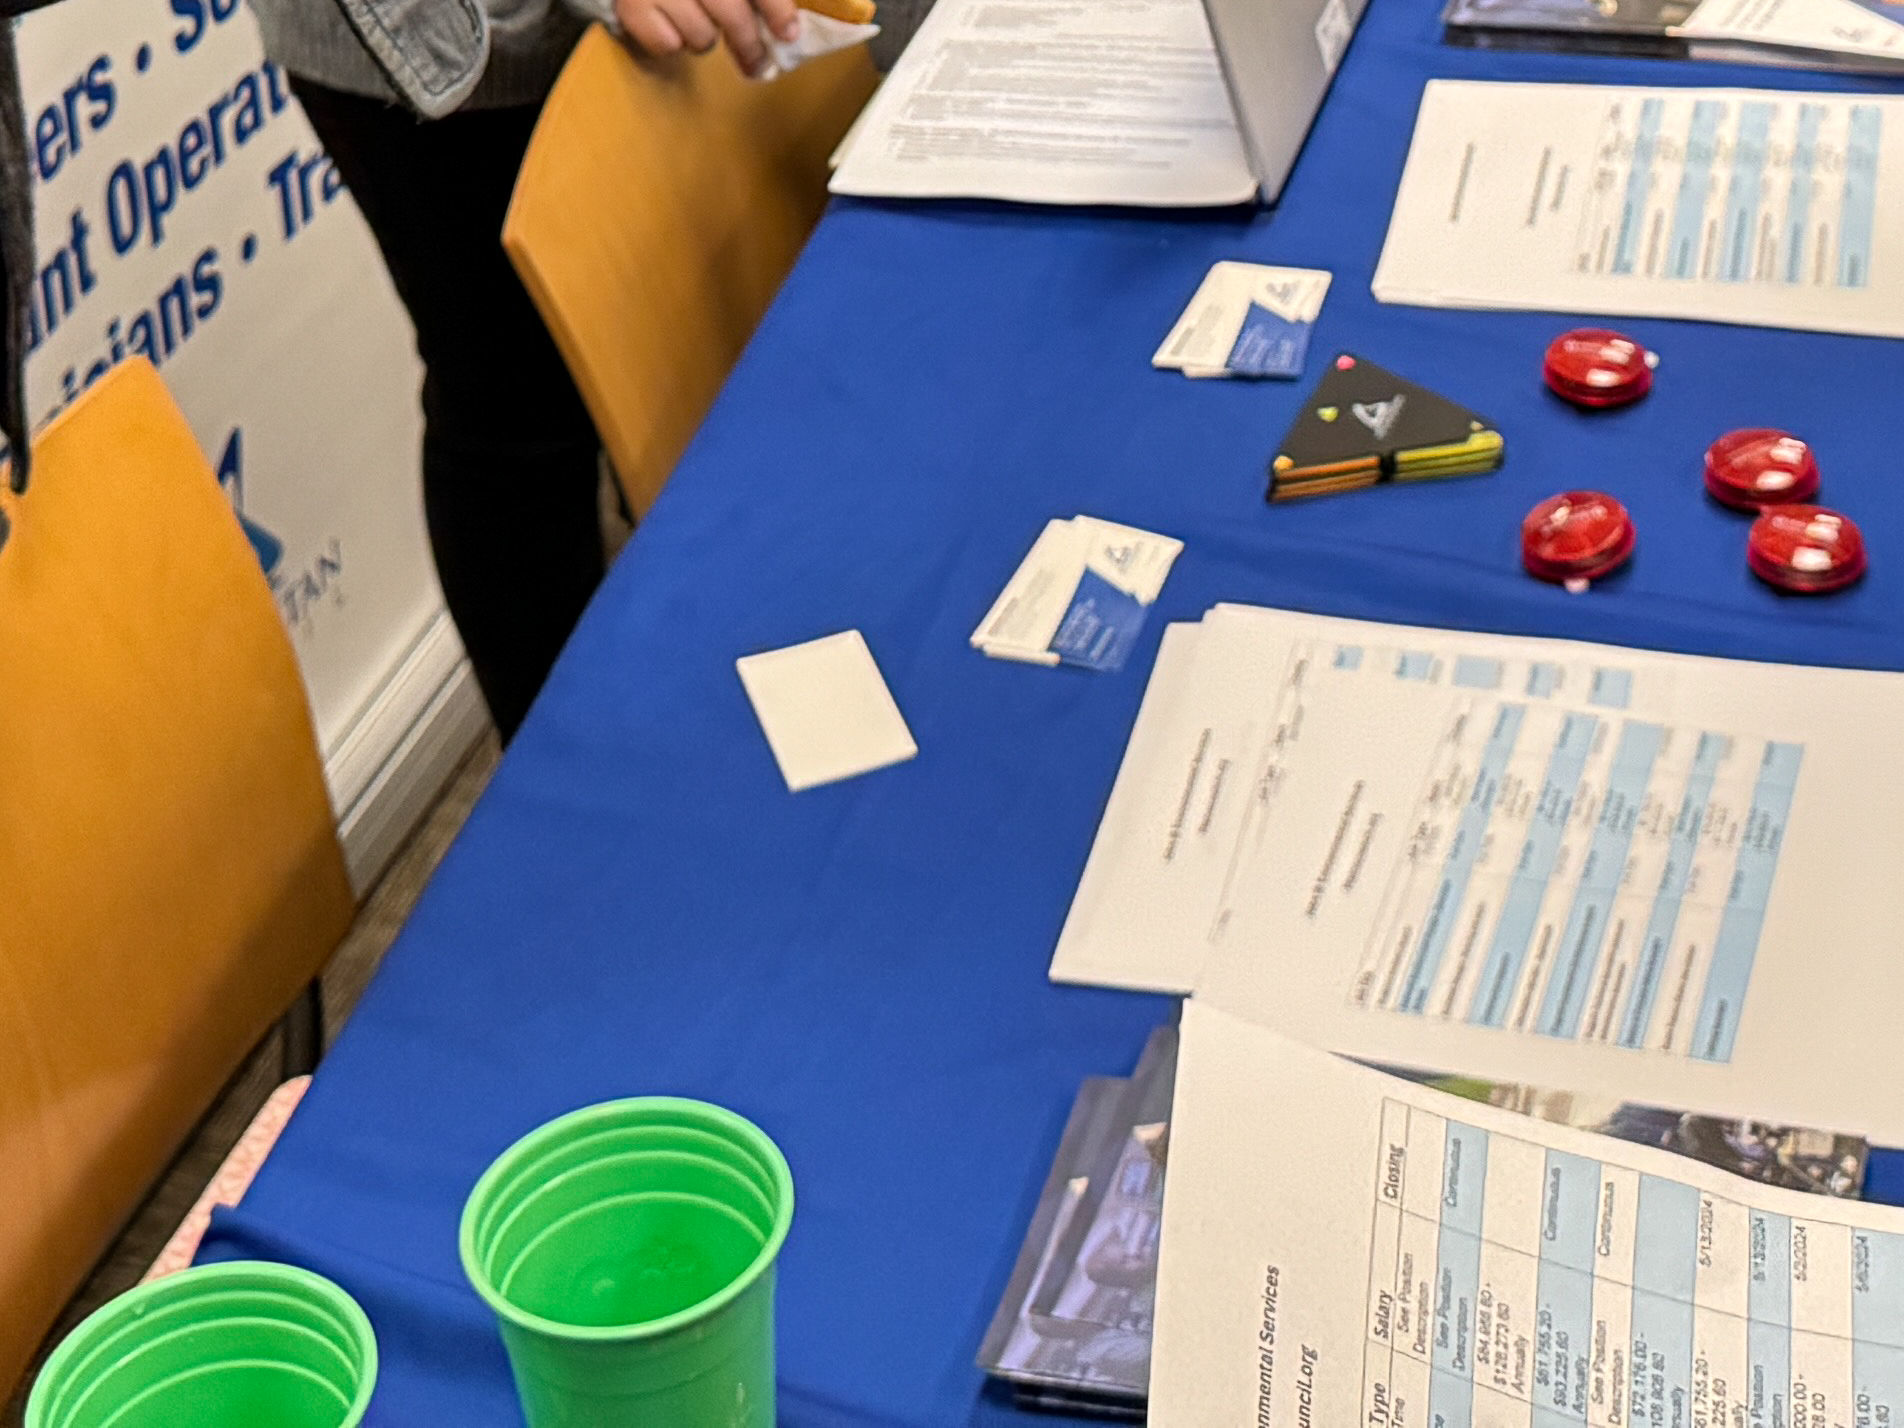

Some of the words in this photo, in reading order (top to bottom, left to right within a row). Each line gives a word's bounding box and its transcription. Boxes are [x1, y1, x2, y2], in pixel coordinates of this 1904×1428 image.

[1383, 1145, 1404, 1199] Closing
[1259, 1265, 1280, 1345] Services
[1374, 1290, 1394, 1339] Salary
[1368, 1382, 1390, 1424] Type
